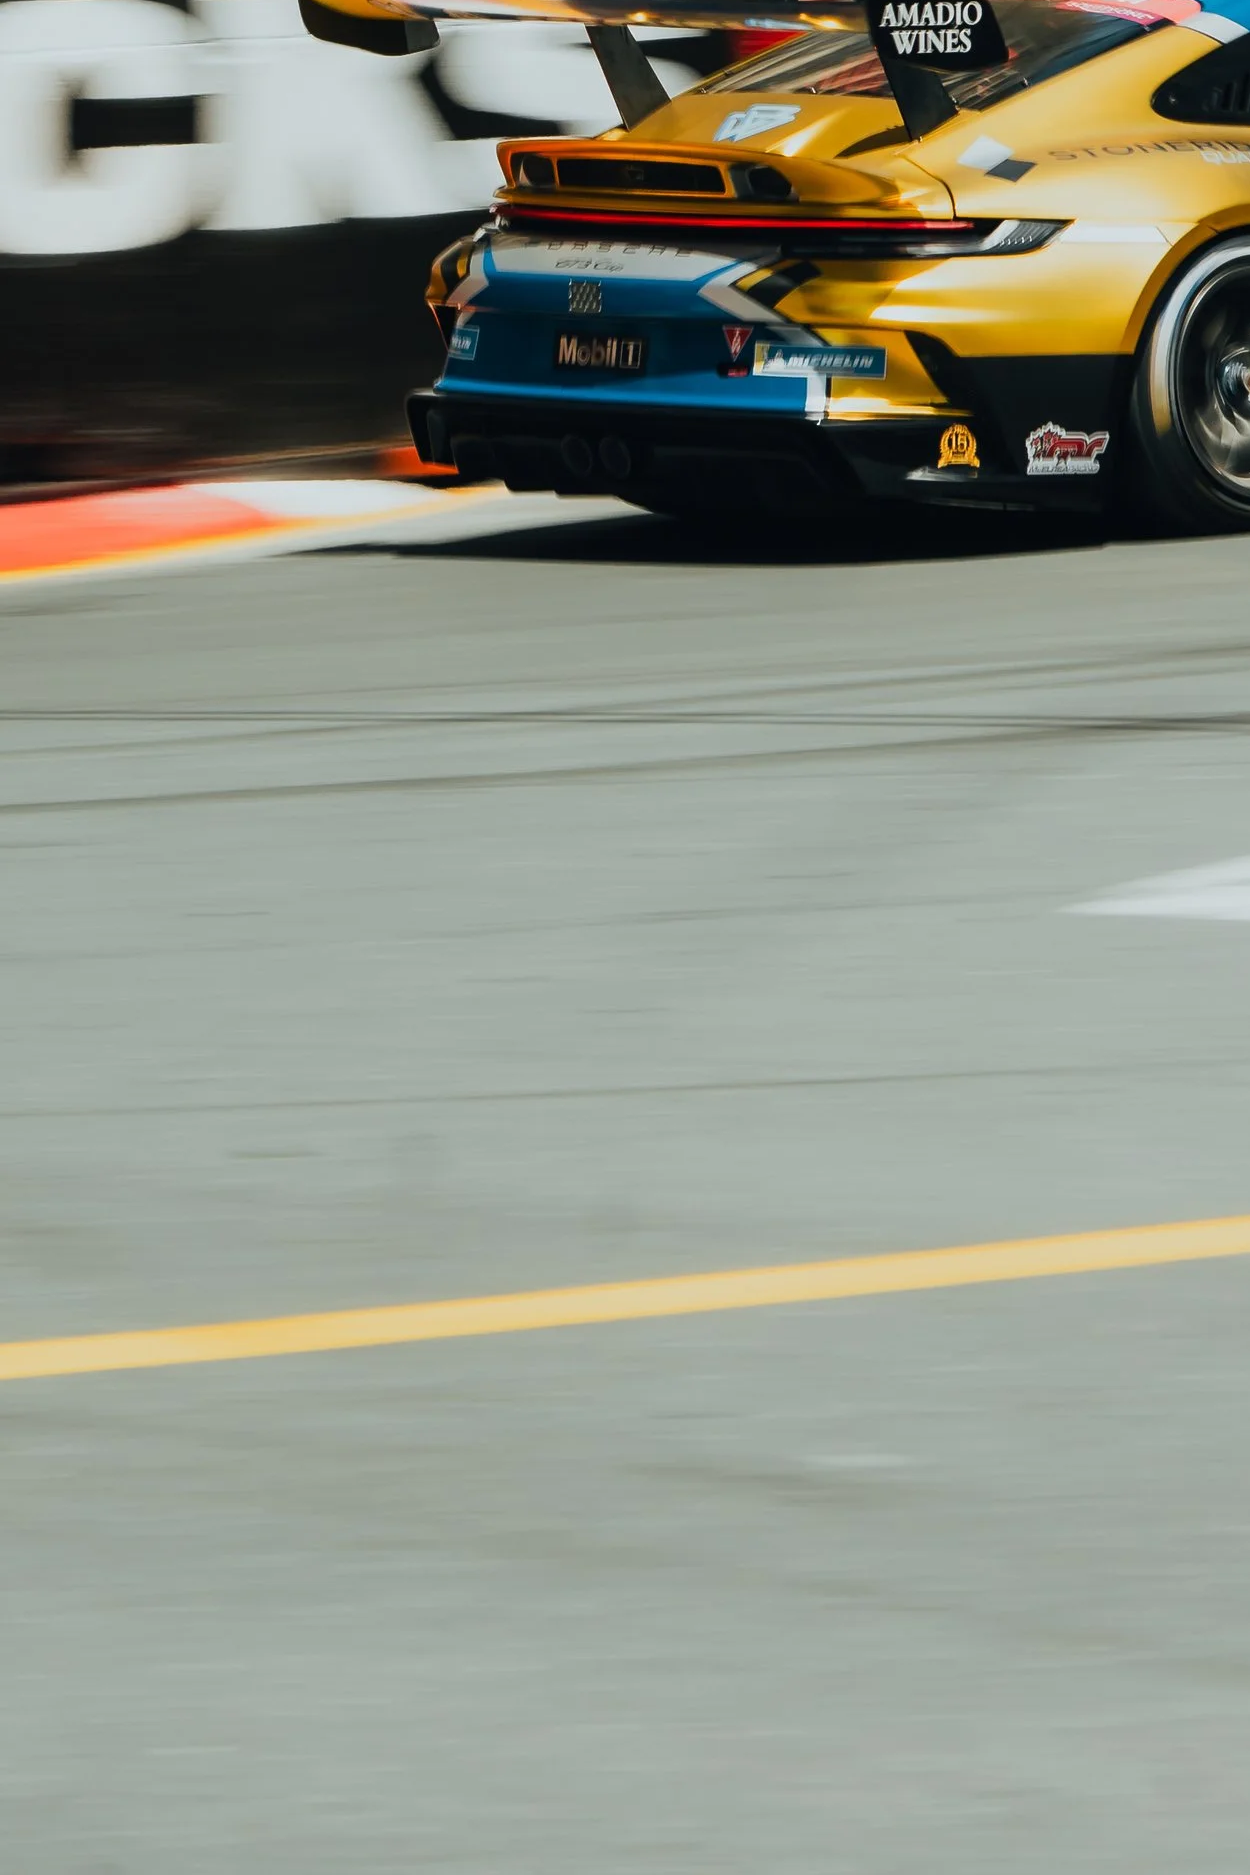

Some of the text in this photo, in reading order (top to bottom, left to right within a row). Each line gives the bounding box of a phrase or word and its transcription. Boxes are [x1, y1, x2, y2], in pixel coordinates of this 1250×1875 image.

[879, 0, 983, 28] AMADIO
[890, 27, 972, 55] WINES
[558, 334, 617, 367] Mobil
[788, 353, 874, 369] MICHELIN
